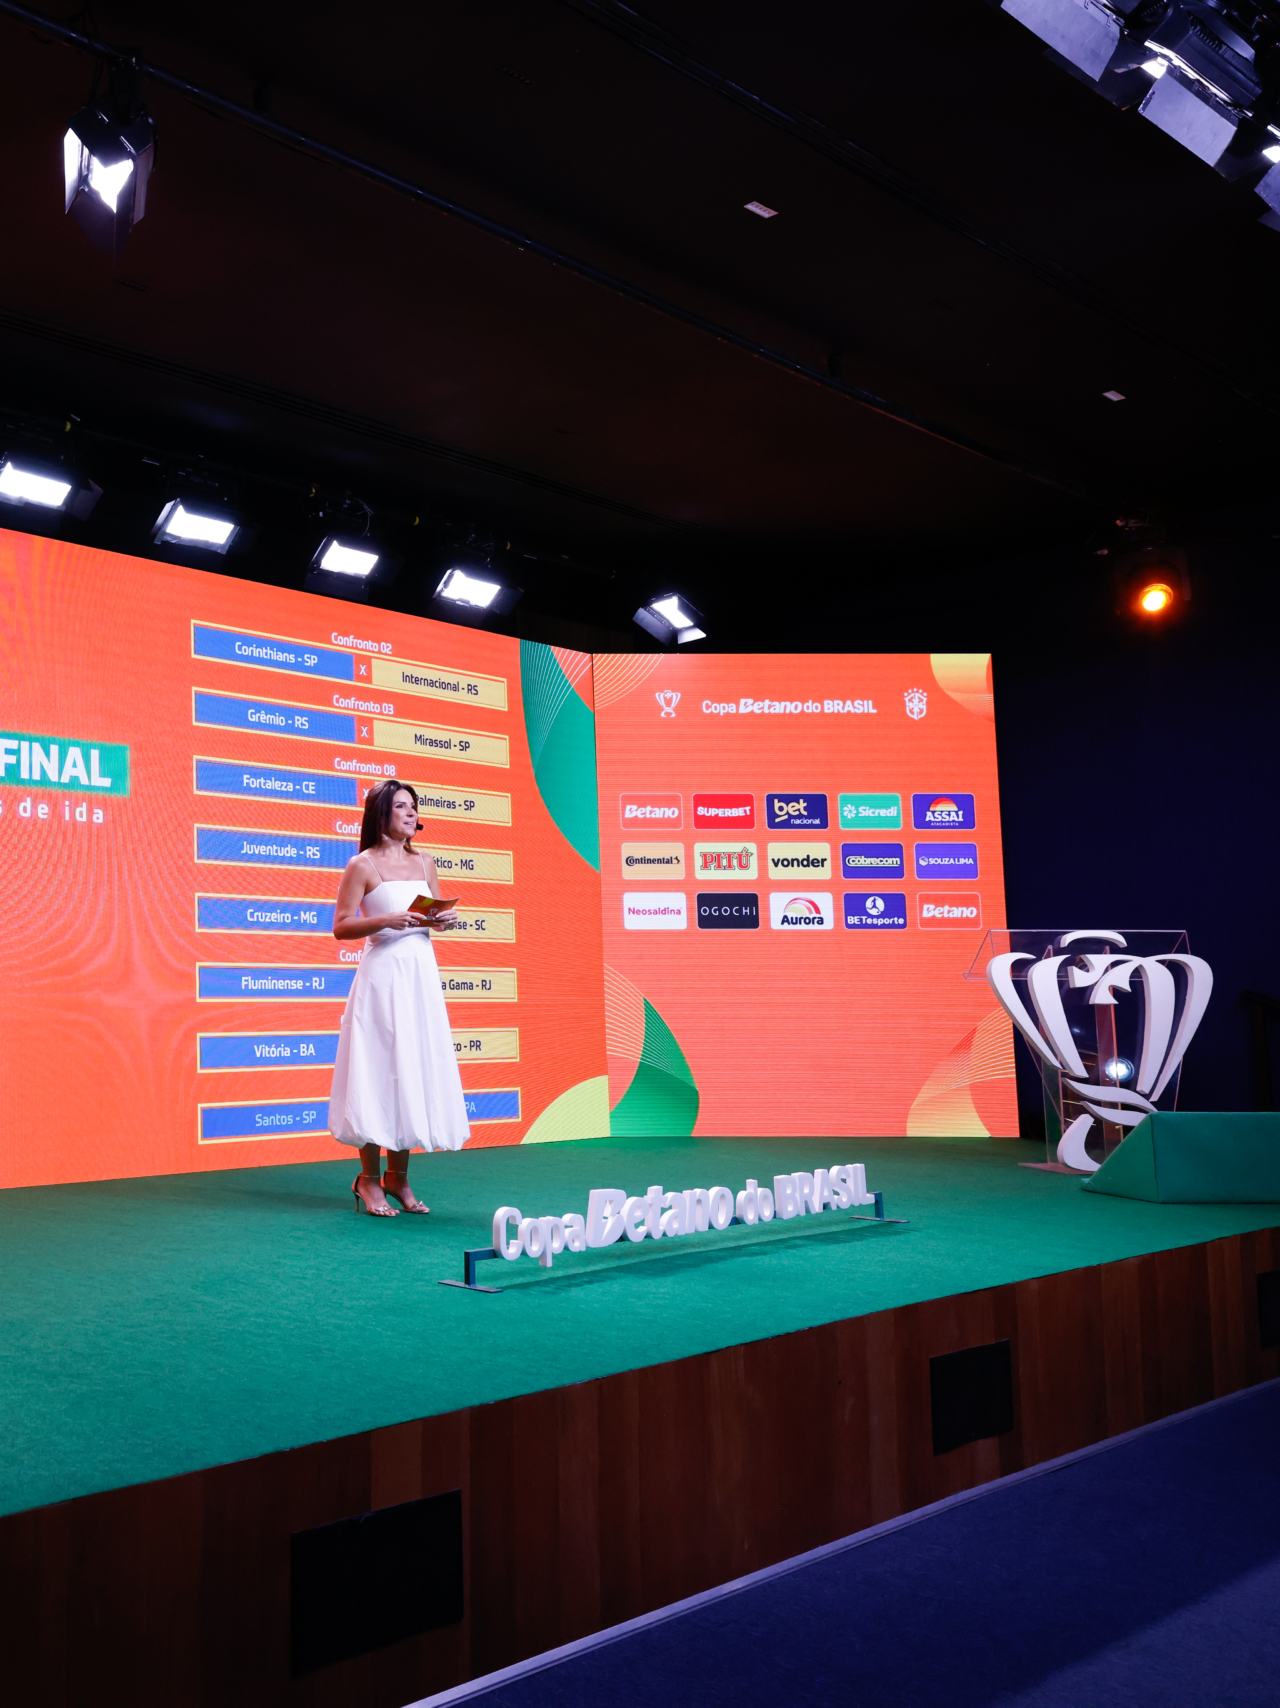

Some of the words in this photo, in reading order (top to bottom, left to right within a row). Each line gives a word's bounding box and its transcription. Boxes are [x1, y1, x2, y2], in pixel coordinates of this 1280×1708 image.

[331, 632, 379, 652] Confronto
[380, 642, 393, 654] 02
[235, 641, 296, 663] Corinthians
[304, 654, 318, 667] SP
[402, 672, 460, 693] Internacional
[467, 683, 479, 696] RS
[333, 694, 381, 713] Confronto
[382, 703, 394, 715] 03
[702, 700, 736, 716] Copa
[738, 698, 802, 714] Betano
[803, 700, 821, 714] do
[823, 700, 877, 714] BRASIL
[248, 709, 286, 727] Grêmio
[295, 715, 309, 729] RS
[414, 733, 452, 750] Mirassol
[459, 740, 470, 752] SP
[334, 757, 382, 775] Confronto
[383, 764, 396, 776] 08
[243, 774, 294, 792] Fortaleza
[302, 781, 316, 794] CE
[18, 797, 49, 820] de
[65, 801, 105, 824] ida
[463, 800, 475, 811] SP
[624, 805, 679, 818] Betano
[697, 806, 751, 817] SUPERBET
[774, 798, 807, 816] bet
[858, 806, 897, 817] Sicredi
[790, 817, 821, 825] nacional
[241, 841, 297, 858] Juventude
[306, 846, 320, 859] RS
[460, 859, 474, 871] MG
[625, 856, 673, 867] Continental
[699, 847, 752, 870] PITÚ
[771, 854, 827, 868] vonder
[847, 856, 900, 867] cobrecom
[247, 909, 291, 923] Cruzeiro
[300, 911, 317, 924] MG
[627, 907, 682, 916] Neosaldina
[700, 906, 756, 916] OGOCHI
[922, 904, 977, 918] Betano
[475, 920, 486, 930] SC
[780, 915, 824, 926] Aurora
[847, 916, 904, 926] BETesporte
[241, 976, 303, 990] Fluminense
[312, 977, 325, 990] RJ
[448, 979, 474, 991] Gama
[481, 980, 492, 991] RJ
[254, 1044, 291, 1058] Vitória
[300, 1044, 316, 1056] BA
[469, 1040, 482, 1051] PR
[255, 1113, 293, 1127] Santos
[303, 1111, 317, 1123] SP
[492, 1206, 586, 1268] Copa
[585, 1185, 735, 1249] Betano
[735, 1178, 774, 1225] do
[773, 1163, 875, 1220] BRASIL
